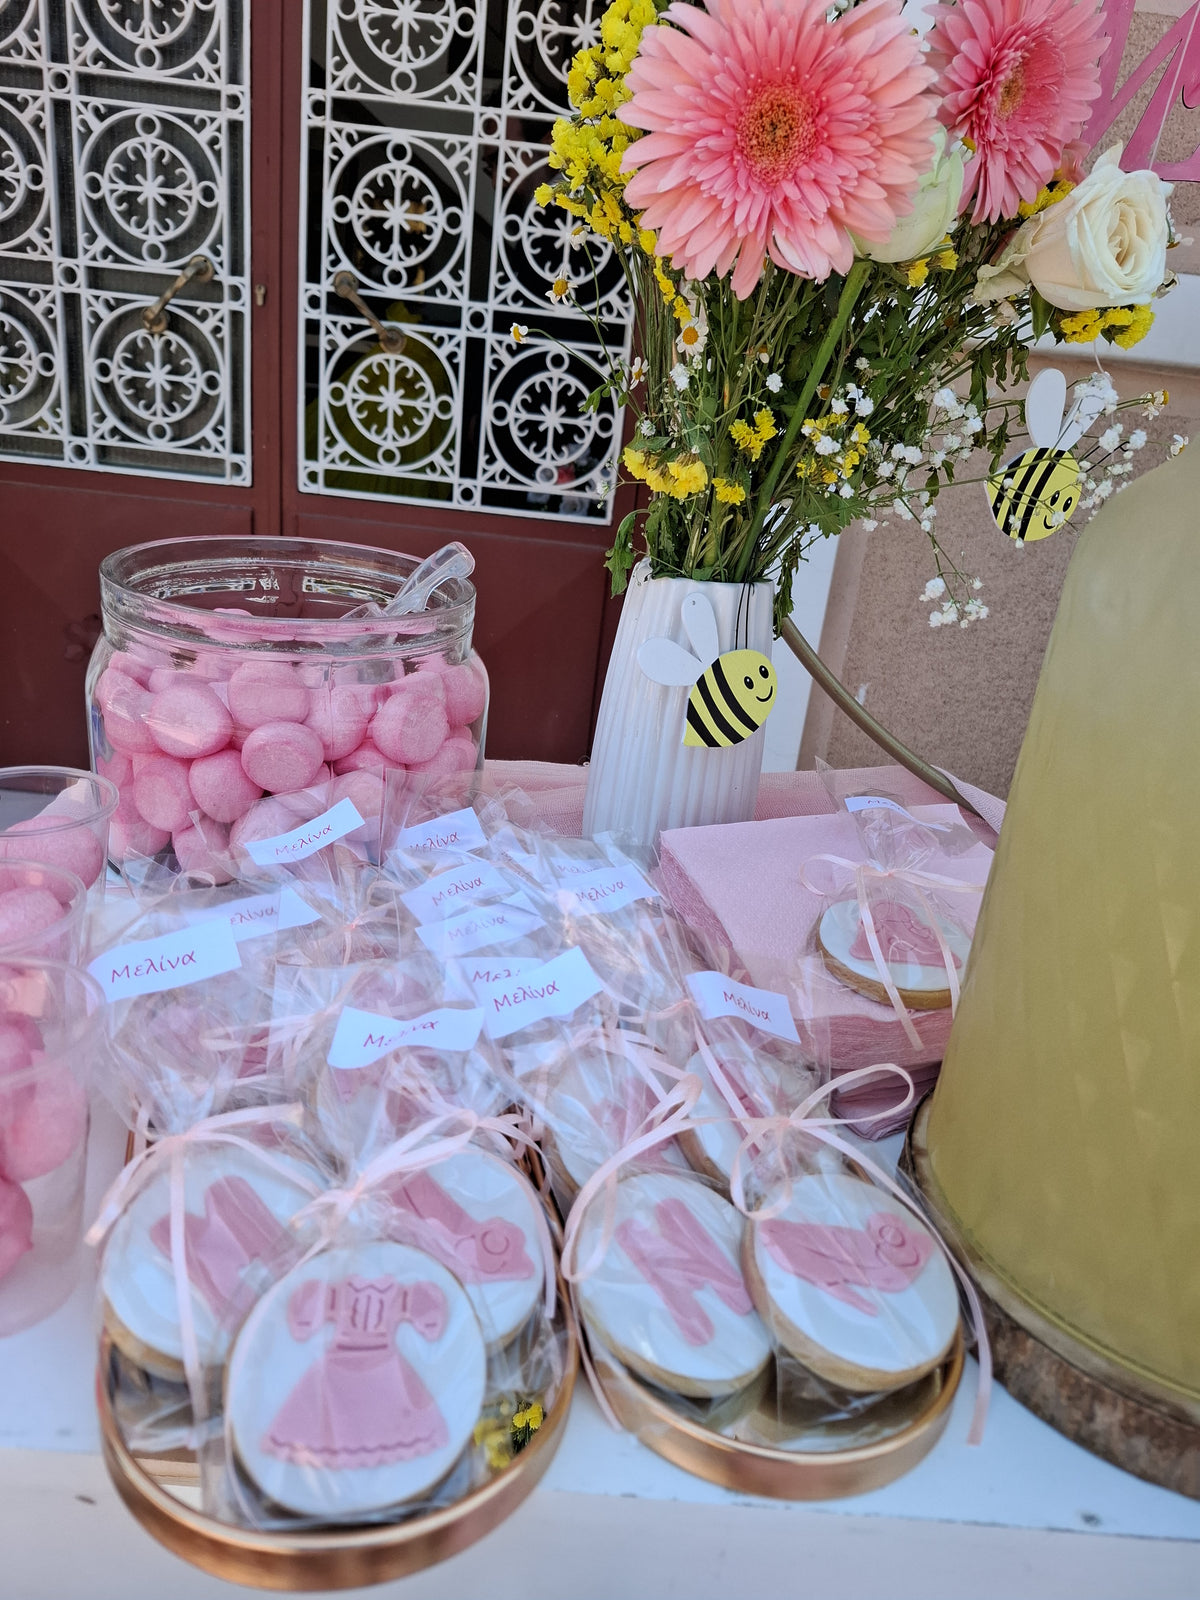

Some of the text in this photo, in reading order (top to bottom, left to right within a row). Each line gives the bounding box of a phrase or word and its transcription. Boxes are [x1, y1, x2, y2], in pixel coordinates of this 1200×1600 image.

[275, 825, 333, 856] Μελίνα
[432, 877, 484, 907] Μελίνα
[575, 880, 625, 902] Μελίνα
[230, 906, 278, 926] ελίνα
[447, 914, 509, 942] Μελίνα
[110, 950, 197, 984] Μελίνα
[493, 980, 560, 1013] Μελίνα
